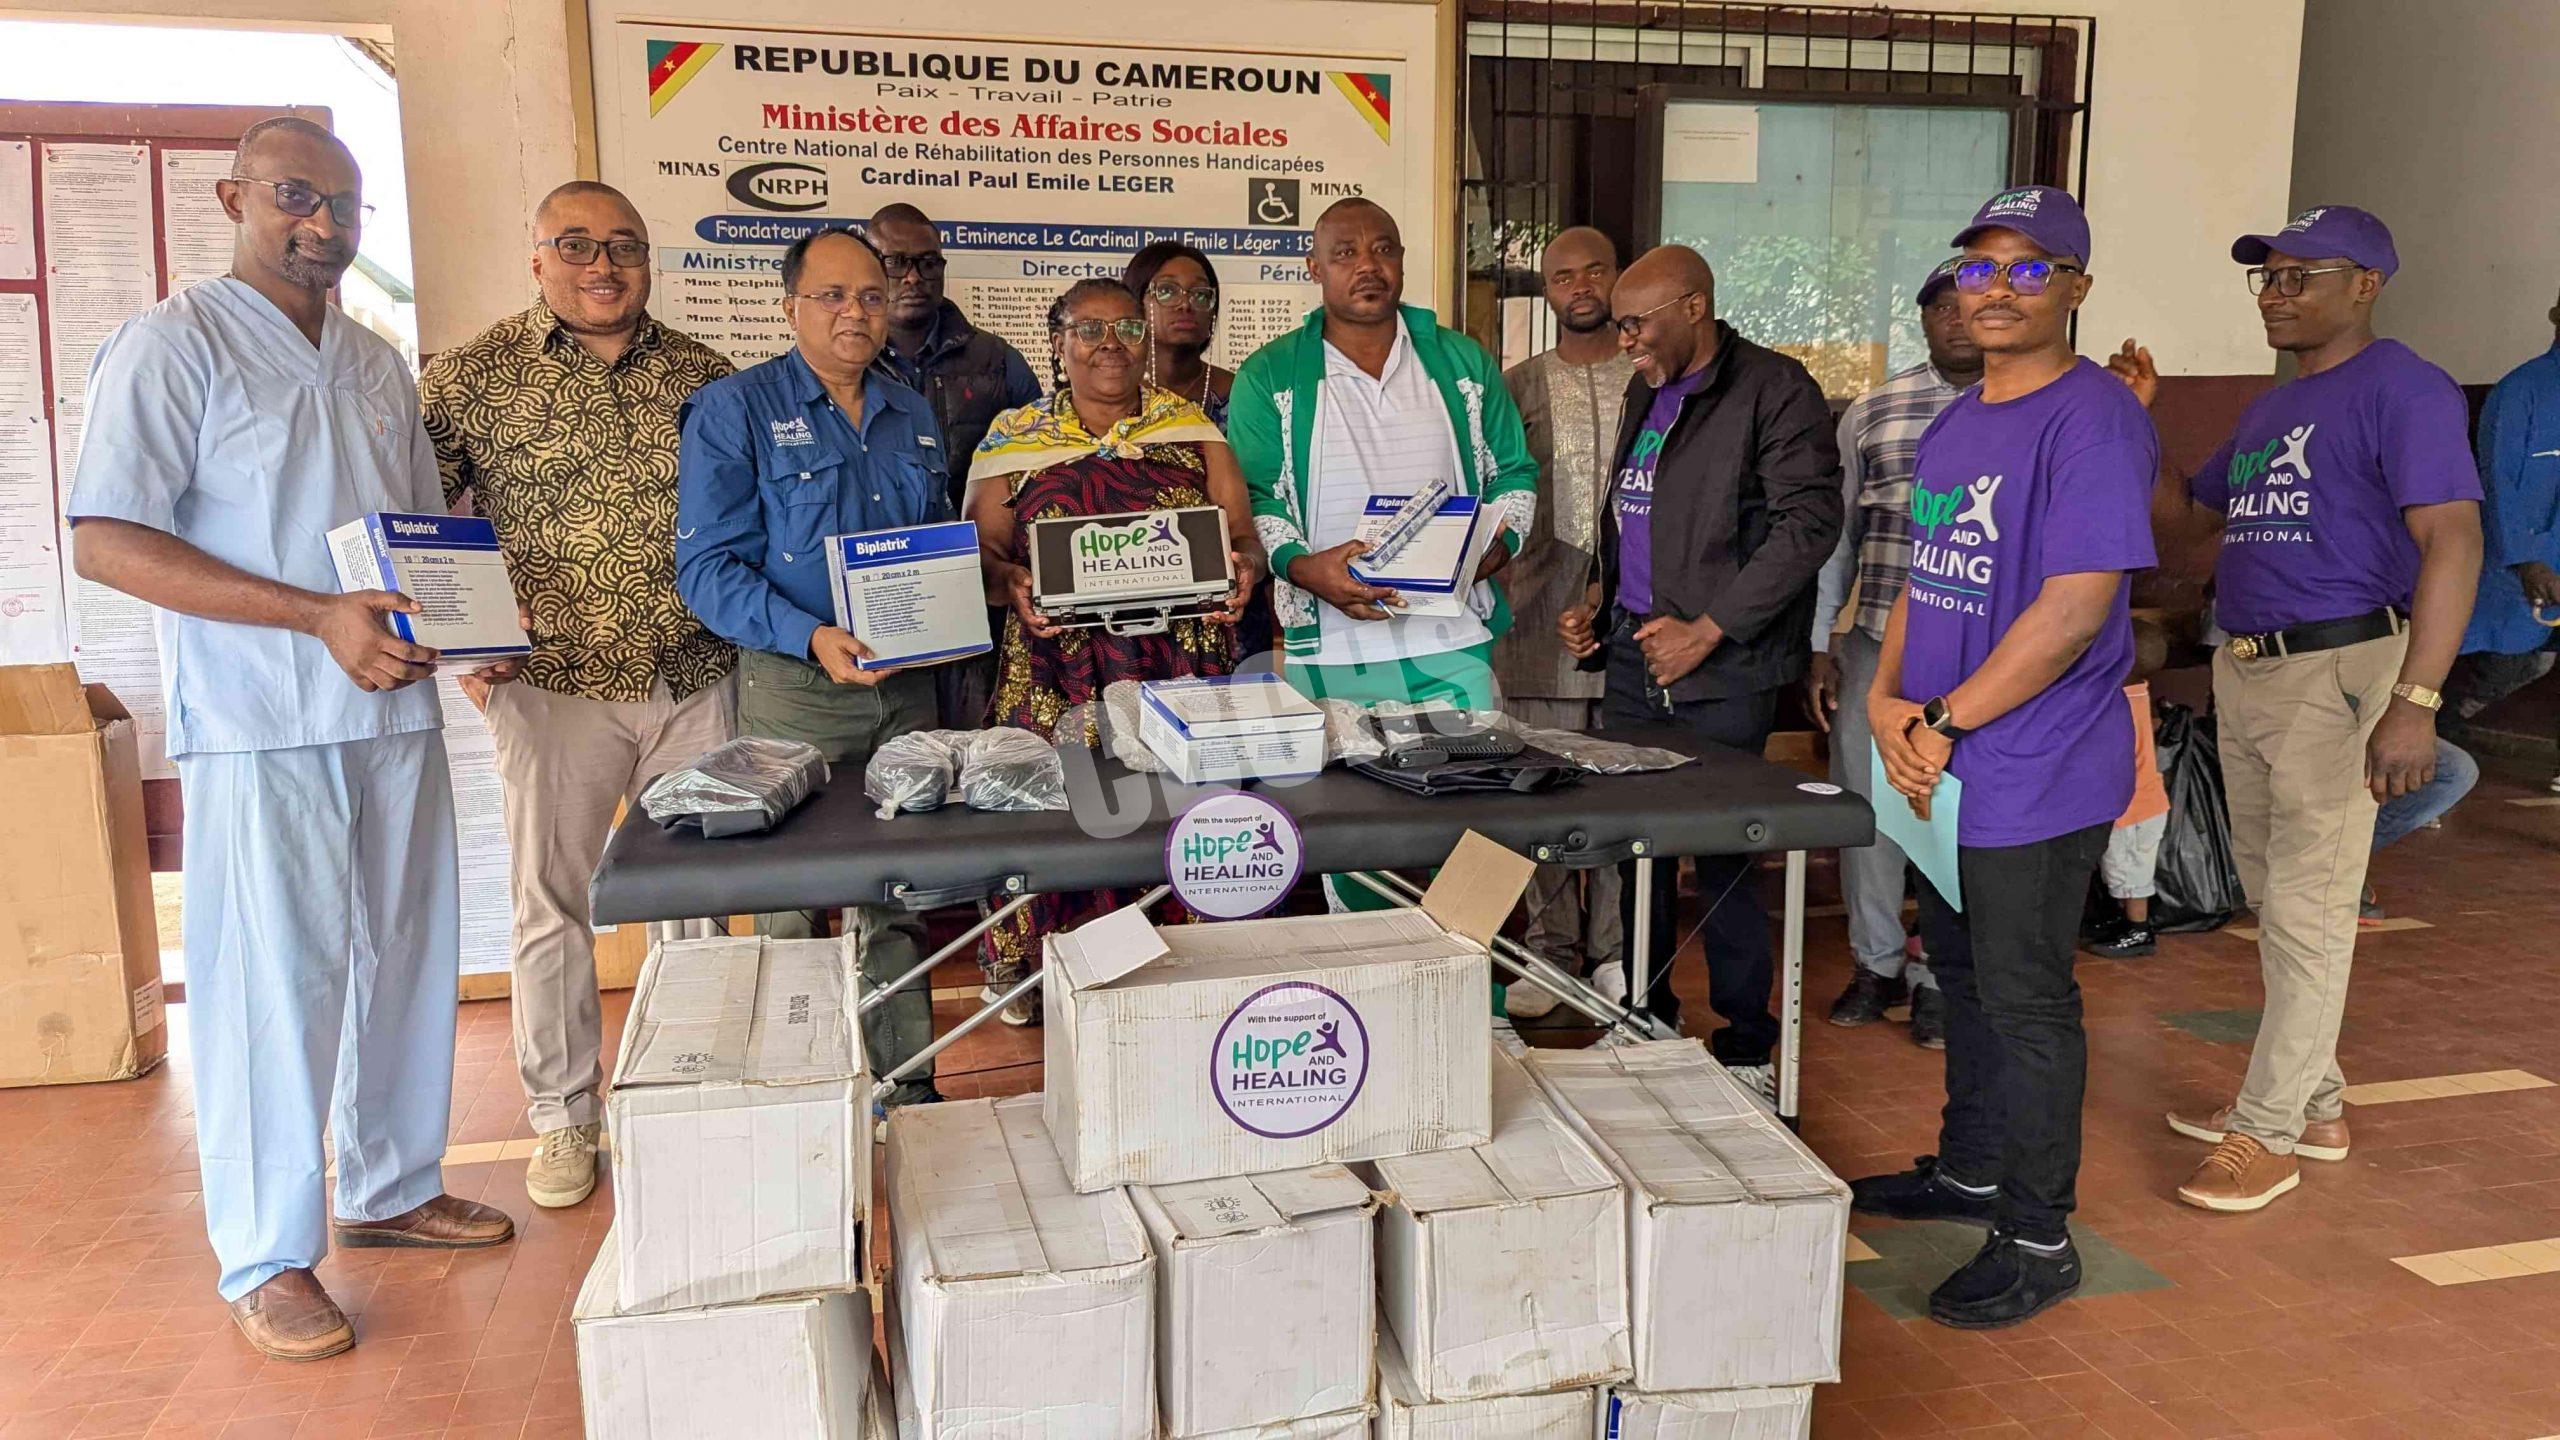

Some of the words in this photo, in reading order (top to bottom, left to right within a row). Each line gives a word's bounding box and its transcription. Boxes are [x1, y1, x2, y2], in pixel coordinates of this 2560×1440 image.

[734, 44, 1010, 81] REPUBLIQUE
[1024, 58, 1080, 85] DU
[1094, 61, 1322, 95] CAMEROUN
[876, 83, 938, 98] Paix
[968, 86, 1061, 104] Travail
[1092, 91, 1173, 107] Patrie
[761, 103, 928, 134] Ministère
[940, 110, 1001, 137] des
[1011, 113, 1141, 142] Affaires
[1152, 118, 1289, 147] Sociales
[718, 135, 787, 155] Centre
[794, 137, 878, 159] National
[885, 142, 908, 160] de
[915, 142, 1051, 165] Réhabilitation
[1057, 148, 1092, 166] des
[1099, 149, 1200, 169] Personnes
[1206, 152, 1325, 176] Handicapées
[658, 161, 720, 177] MINAS
[861, 167, 959, 187] Cardinal
[968, 171, 1017, 190] Paul
[1026, 172, 1090, 192] Emile
[1098, 175, 1175, 194] LEGER
[1310, 182, 1363, 196] MINAS
[1989, 201, 2038, 211] HEALING
[715, 220, 811, 240] Fondateur
[956, 227, 1037, 247] Eminence
[1043, 229, 1064, 246] Le
[1069, 229, 1139, 248] Cardinal
[1184, 232, 1228, 250] Emile
[1234, 233, 1281, 255] Léger
[1260, 264, 1311, 282] Pério
[685, 278, 722, 287] Mme
[728, 279, 783, 289] Delphi
[686, 296, 722, 305] Mme
[728, 296, 767, 305] Rose
[686, 314, 723, 323] Mme
[728, 314, 786, 323] Aïssato
[688, 332, 724, 340] Mme
[730, 333, 773, 341] Marie
[771, 419, 796, 433] Hope
[774, 432, 813, 441] HEALING
[2266, 473, 2293, 486] AND
[1080, 527, 1148, 558] Hope
[1949, 529, 1981, 546] AND
[1146, 544, 1170, 553] AND
[1082, 553, 1183, 573] HEALING
[1084, 574, 1185, 588] INTERNATIONAL
[1225, 815, 1253, 825] support
[1183, 830, 1252, 864] Hope
[1250, 852, 1273, 861] AND
[1184, 863, 1284, 881] HEALING
[1184, 884, 1281, 896] INTERNATIONAL
[1247, 1015, 1266, 1024] With
[1268, 1014, 1282, 1022] the
[1283, 1013, 1316, 1024] support
[1318, 1012, 1327, 1020] of
[1232, 1030, 1312, 1070] Hope
[1308, 1055, 1335, 1066] AND
[1232, 1067, 1347, 1091] HEALING
[1232, 1094, 1346, 1108] INTERNATIONAL
